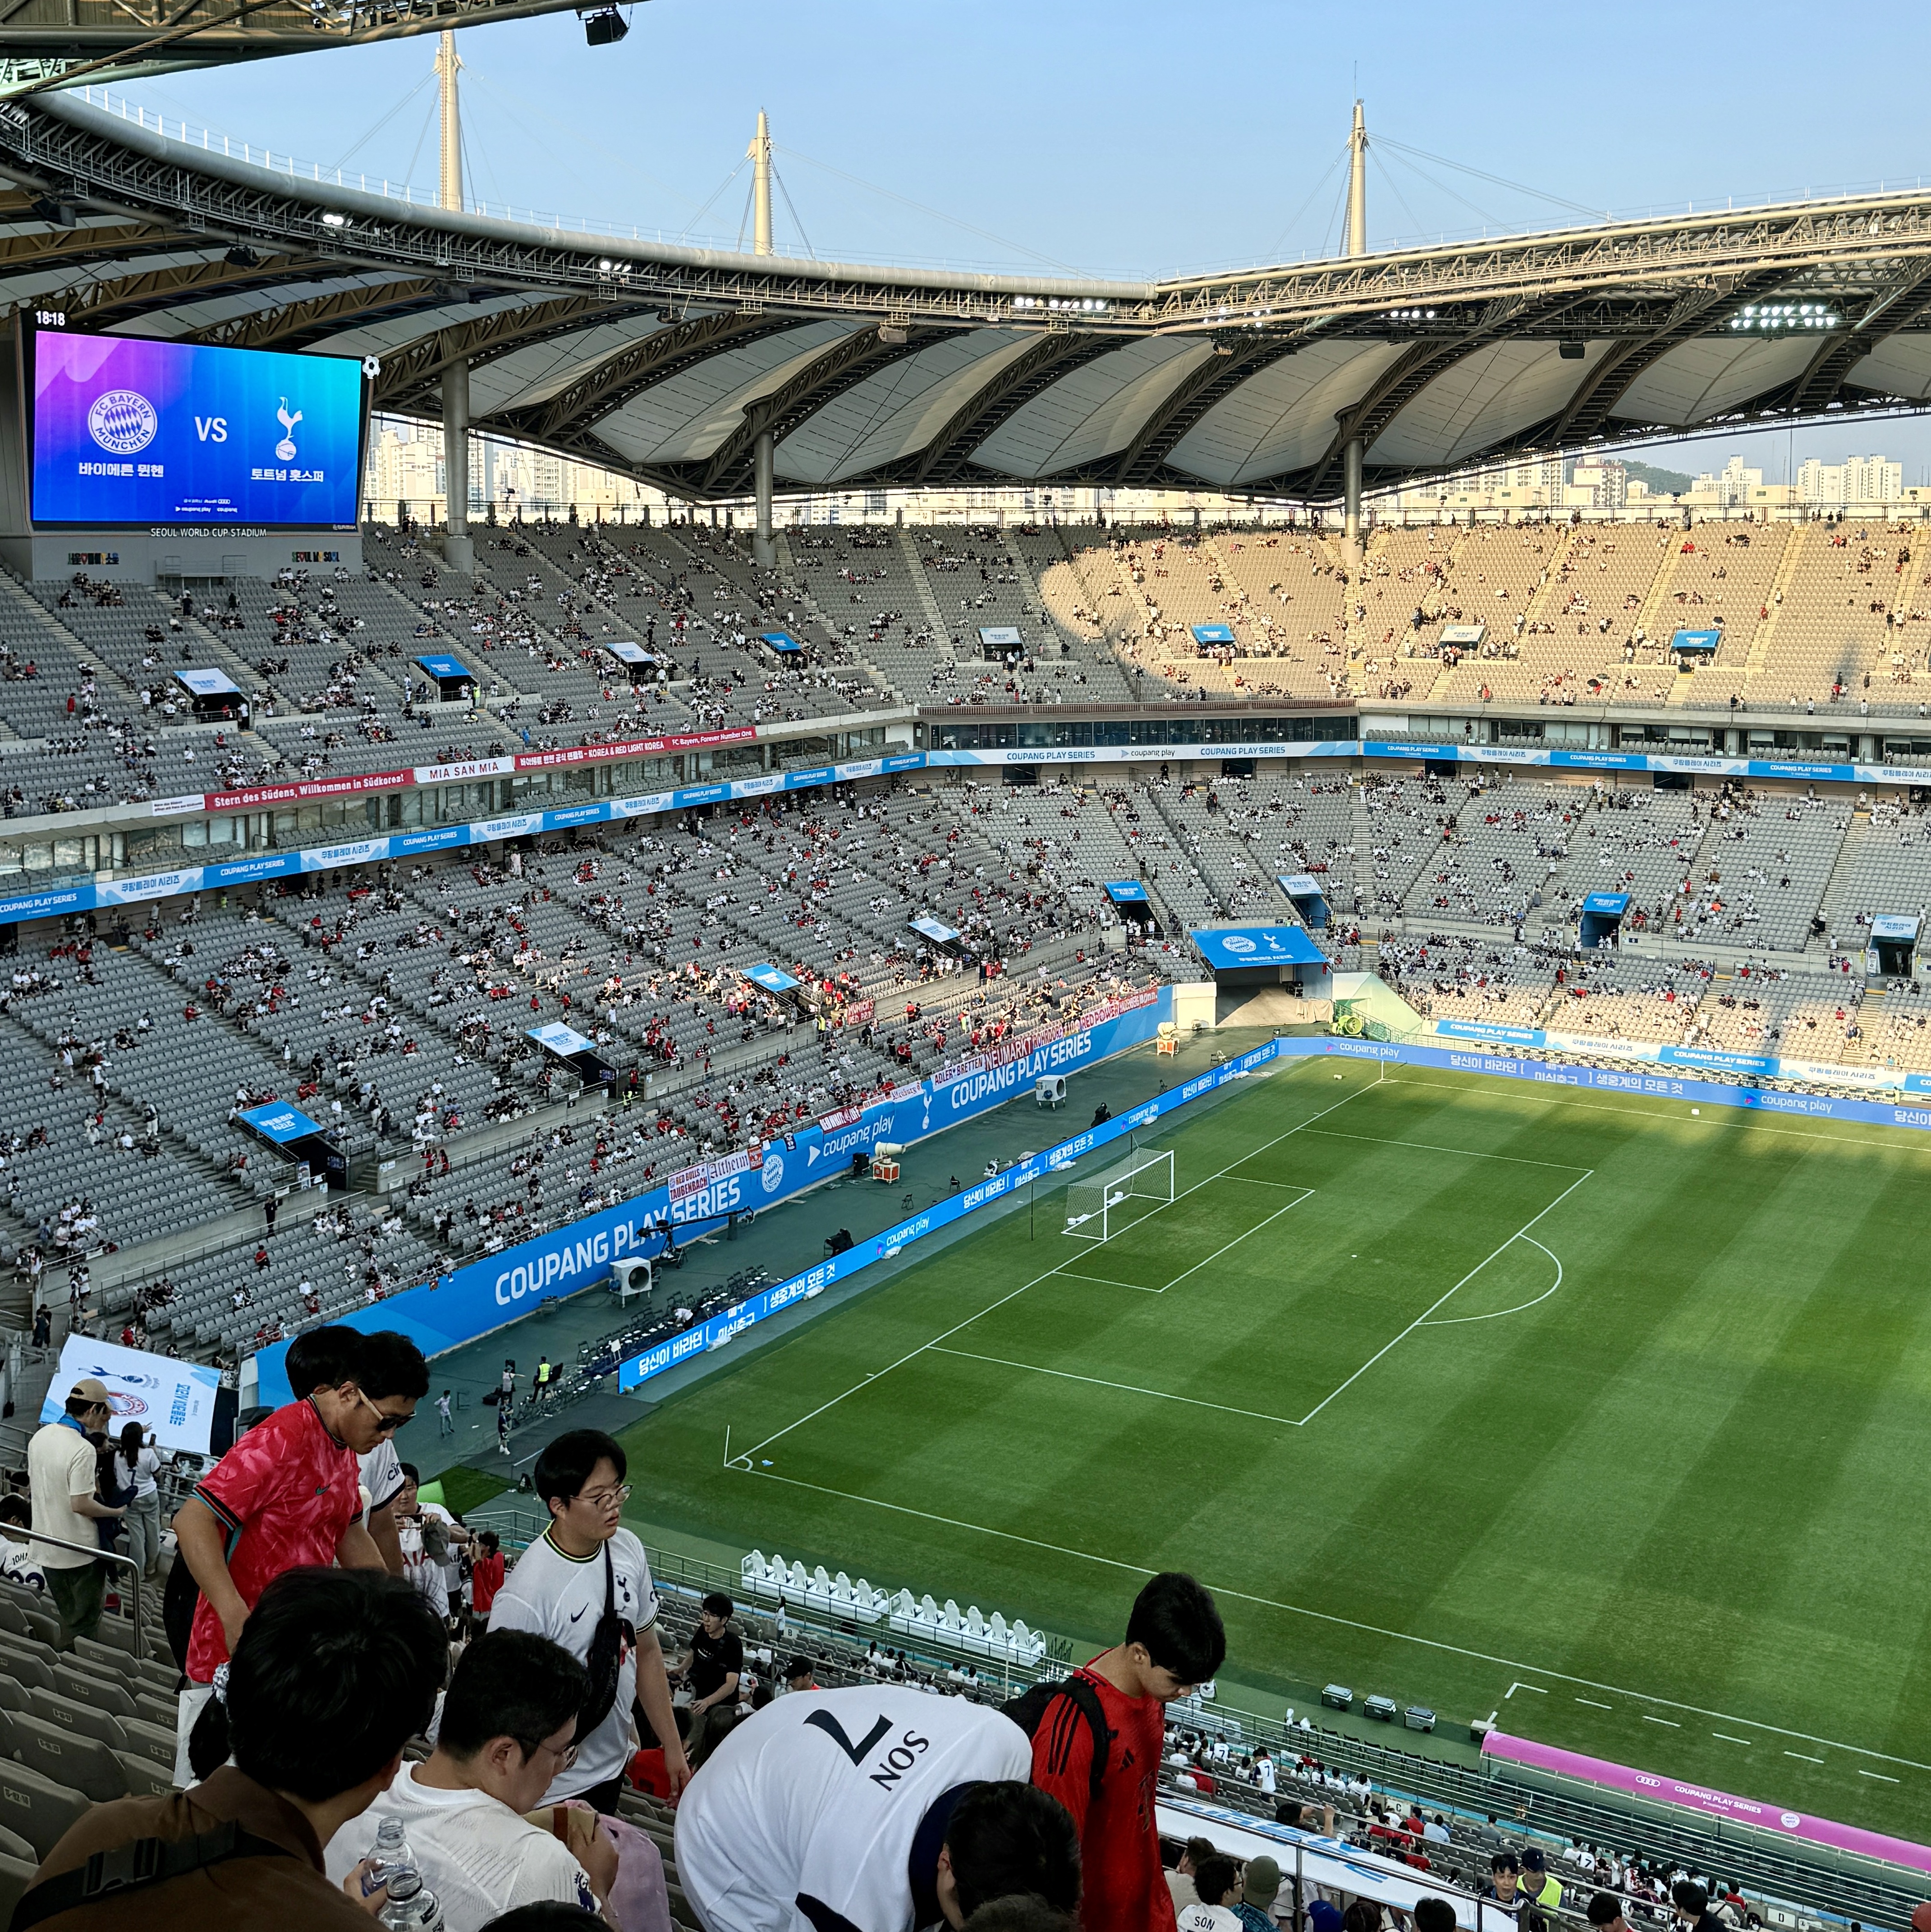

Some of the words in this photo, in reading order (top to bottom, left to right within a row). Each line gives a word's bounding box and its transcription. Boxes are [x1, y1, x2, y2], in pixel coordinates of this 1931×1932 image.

[36, 311, 65, 326] 18:18
[95, 402, 108, 416] FC
[109, 395, 151, 419] BAYERN
[195, 416, 227, 442] VS
[79, 463, 134, 477] 바이에른
[138, 464, 164, 477] 뮌헨
[251, 468, 286, 481] 토트넘
[151, 528, 176, 537] SEOUL
[179, 528, 207, 537] WORLD
[210, 528, 225, 537] CUP
[227, 528, 262, 537] STADIUM
[588, 748, 609, 758] KOREA
[615, 746, 627, 754] RED
[628, 743, 644, 753] LIGHT
[644, 741, 665, 751] KOREA
[430, 768, 450, 779] MIA
[454, 765, 475, 776] SAN
[480, 762, 499, 773] MIA
[215, 797, 240, 807] Stern
[243, 793, 259, 803] des
[261, 789, 298, 800] Südens,
[299, 782, 351, 795] Willkommen
[353, 779, 361, 789] in
[363, 774, 404, 787] Südkorea!
[403, 836, 427, 846] COUPANG
[440, 831, 457, 840] SERIES
[220, 866, 249, 877] COUPANG
[249, 862, 265, 871] PLAY
[264, 859, 285, 869] SERIES
[159, 875, 181, 886] 시리즈
[0, 900, 33, 913] COUPANG
[34, 897, 52, 907] PLAY
[52, 893, 77, 904] SERIES
[1081, 1014, 1095, 1028] RED
[1095, 1004, 1119, 1024] POWER
[1450, 1023, 1486, 1033] COUPANG
[1486, 1028, 1507, 1036] PLAY
[1507, 1031, 1533, 1039] SERIES
[985, 1037, 1032, 1071] NEUMARKT
[1339, 1043, 1379, 1056] coupang
[1381, 1046, 1399, 1059] play
[1610, 1043, 1633, 1051] 시리즈
[1450, 1054, 1482, 1069] 당신이
[1484, 1059, 1517, 1073] 바라던
[1674, 1051, 1713, 1061] COUPANG
[1714, 1055, 1737, 1064] PLAY
[1736, 1058, 1766, 1067] SERIES
[935, 1069, 954, 1085] ADLER
[957, 1055, 983, 1075] BRETTEN
[951, 1063, 1015, 1109] COUPANG
[1018, 1047, 1050, 1081] PLAY
[1050, 1034, 1092, 1067] SERIES
[1850, 1072, 1876, 1080] 시리즈
[1596, 1073, 1642, 1089] 생중계의
[1644, 1079, 1668, 1092] 모든
[1671, 1082, 1683, 1095] 것
[1761, 1096, 1808, 1111] coupang
[1810, 1100, 1833, 1114] play
[823, 1126, 871, 1157] coupang
[872, 1115, 894, 1142] play
[1074, 1136, 1087, 1153] 모든
[1087, 1133, 1094, 1147] 것
[709, 1155, 749, 1179] Altheim
[675, 1174, 685, 1185] RED
[685, 1168, 701, 1181] BULLS
[670, 1176, 708, 1201] TAUBENBACH
[886, 1224, 915, 1247] coupang
[916, 1216, 930, 1235] play
[495, 1231, 609, 1306] COUPANG
[671, 1176, 741, 1230] SERIES
[807, 1267, 824, 1290] 모든
[826, 1262, 835, 1280] 것
[638, 1346, 670, 1377] 당신이
[672, 1330, 702, 1359] 바라던
[788, 1628, 792, 1636] B
[803, 1709, 894, 1767] 7
[869, 1730, 930, 1792] SON
[1219, 1749, 1225, 1758] 7
[1264, 1765, 1270, 1776] 7
[1396, 1803, 1402, 1812] C
[1674, 1785, 1712, 1800] COUPANG
[1712, 1795, 1734, 1806] PLAY
[1733, 1801, 1762, 1814] SERIES
[1584, 1858, 1592, 1868] 7
[1194, 1916, 1215, 1931] SON
[1778, 1913, 1784, 1923] D
